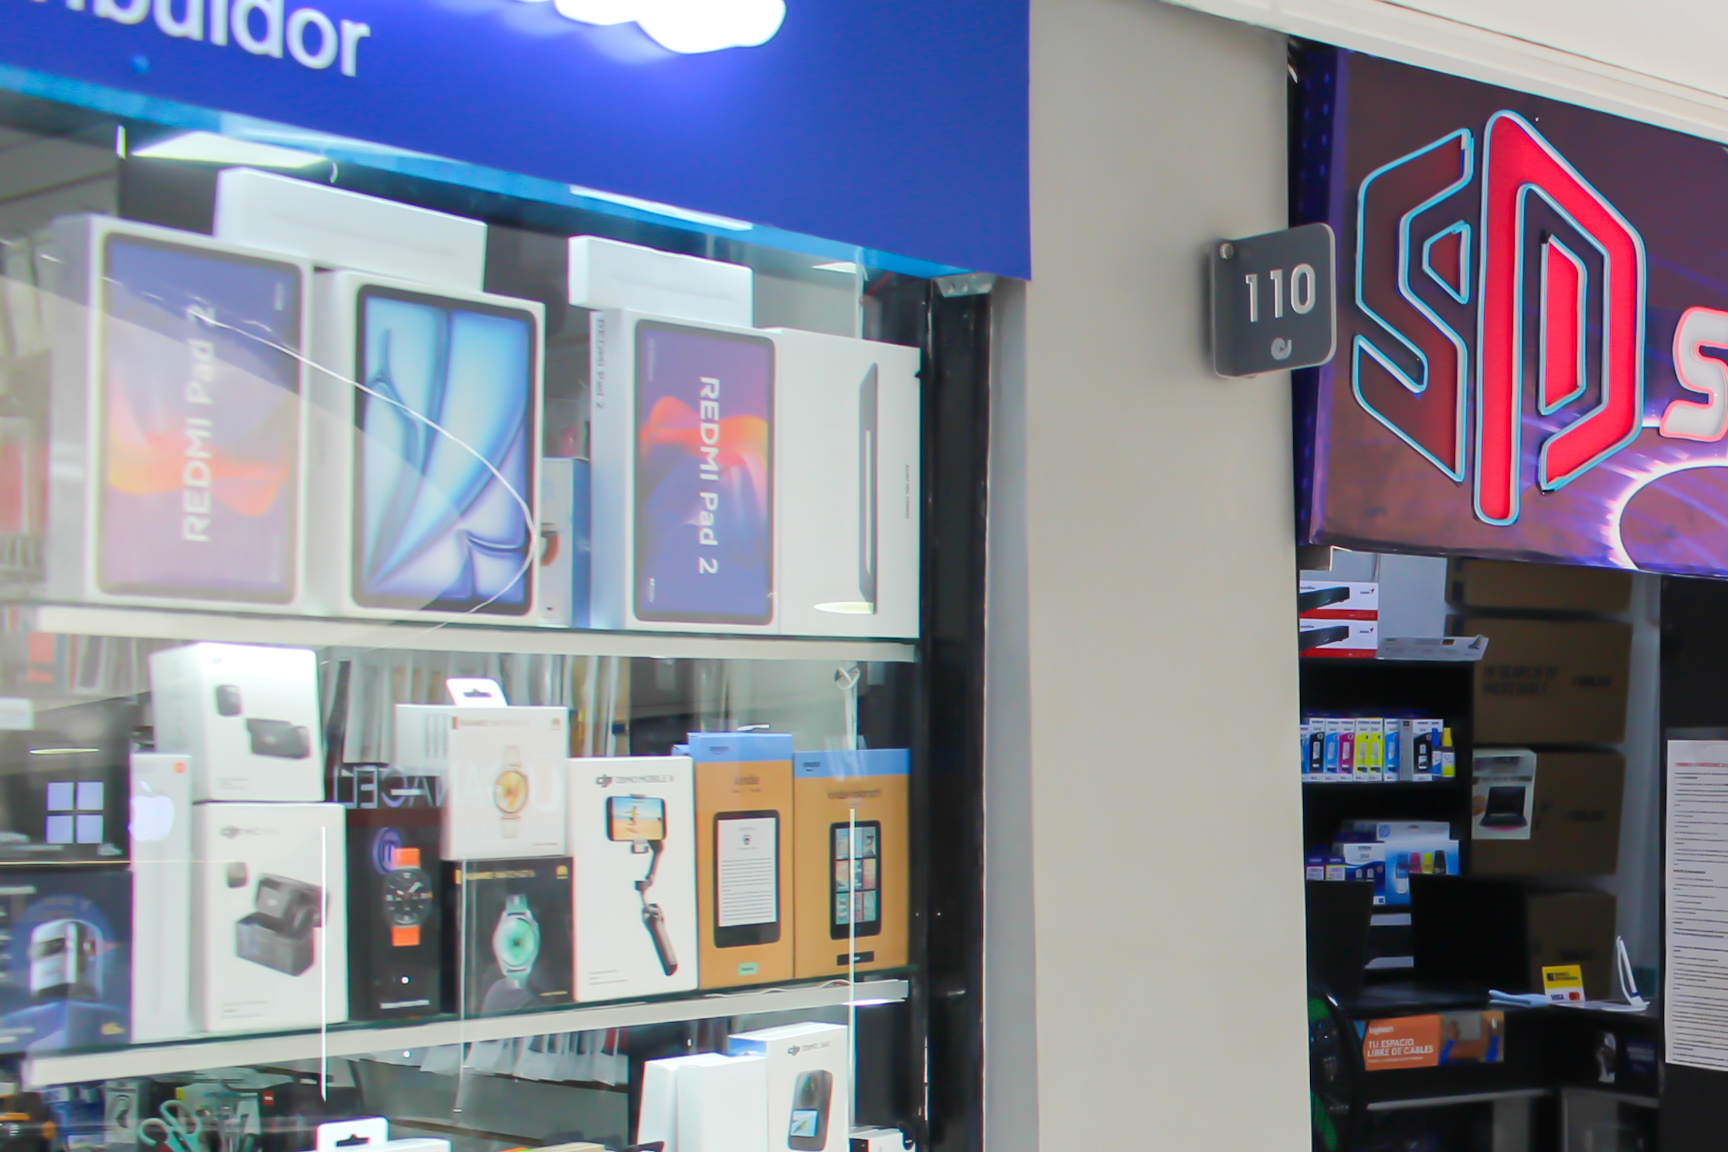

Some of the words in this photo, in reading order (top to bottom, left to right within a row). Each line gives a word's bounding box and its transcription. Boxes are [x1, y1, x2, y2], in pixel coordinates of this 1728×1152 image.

[1245, 263, 1316, 323] 110
[186, 339, 215, 404] Pad
[700, 376, 721, 481] REDMI
[182, 417, 214, 542] REDMI
[699, 491, 719, 546] Pad
[699, 556, 719, 575] 2
[1381, 1038, 1415, 1047] ESPACIO
[1403, 1045, 1434, 1054] CABLES
